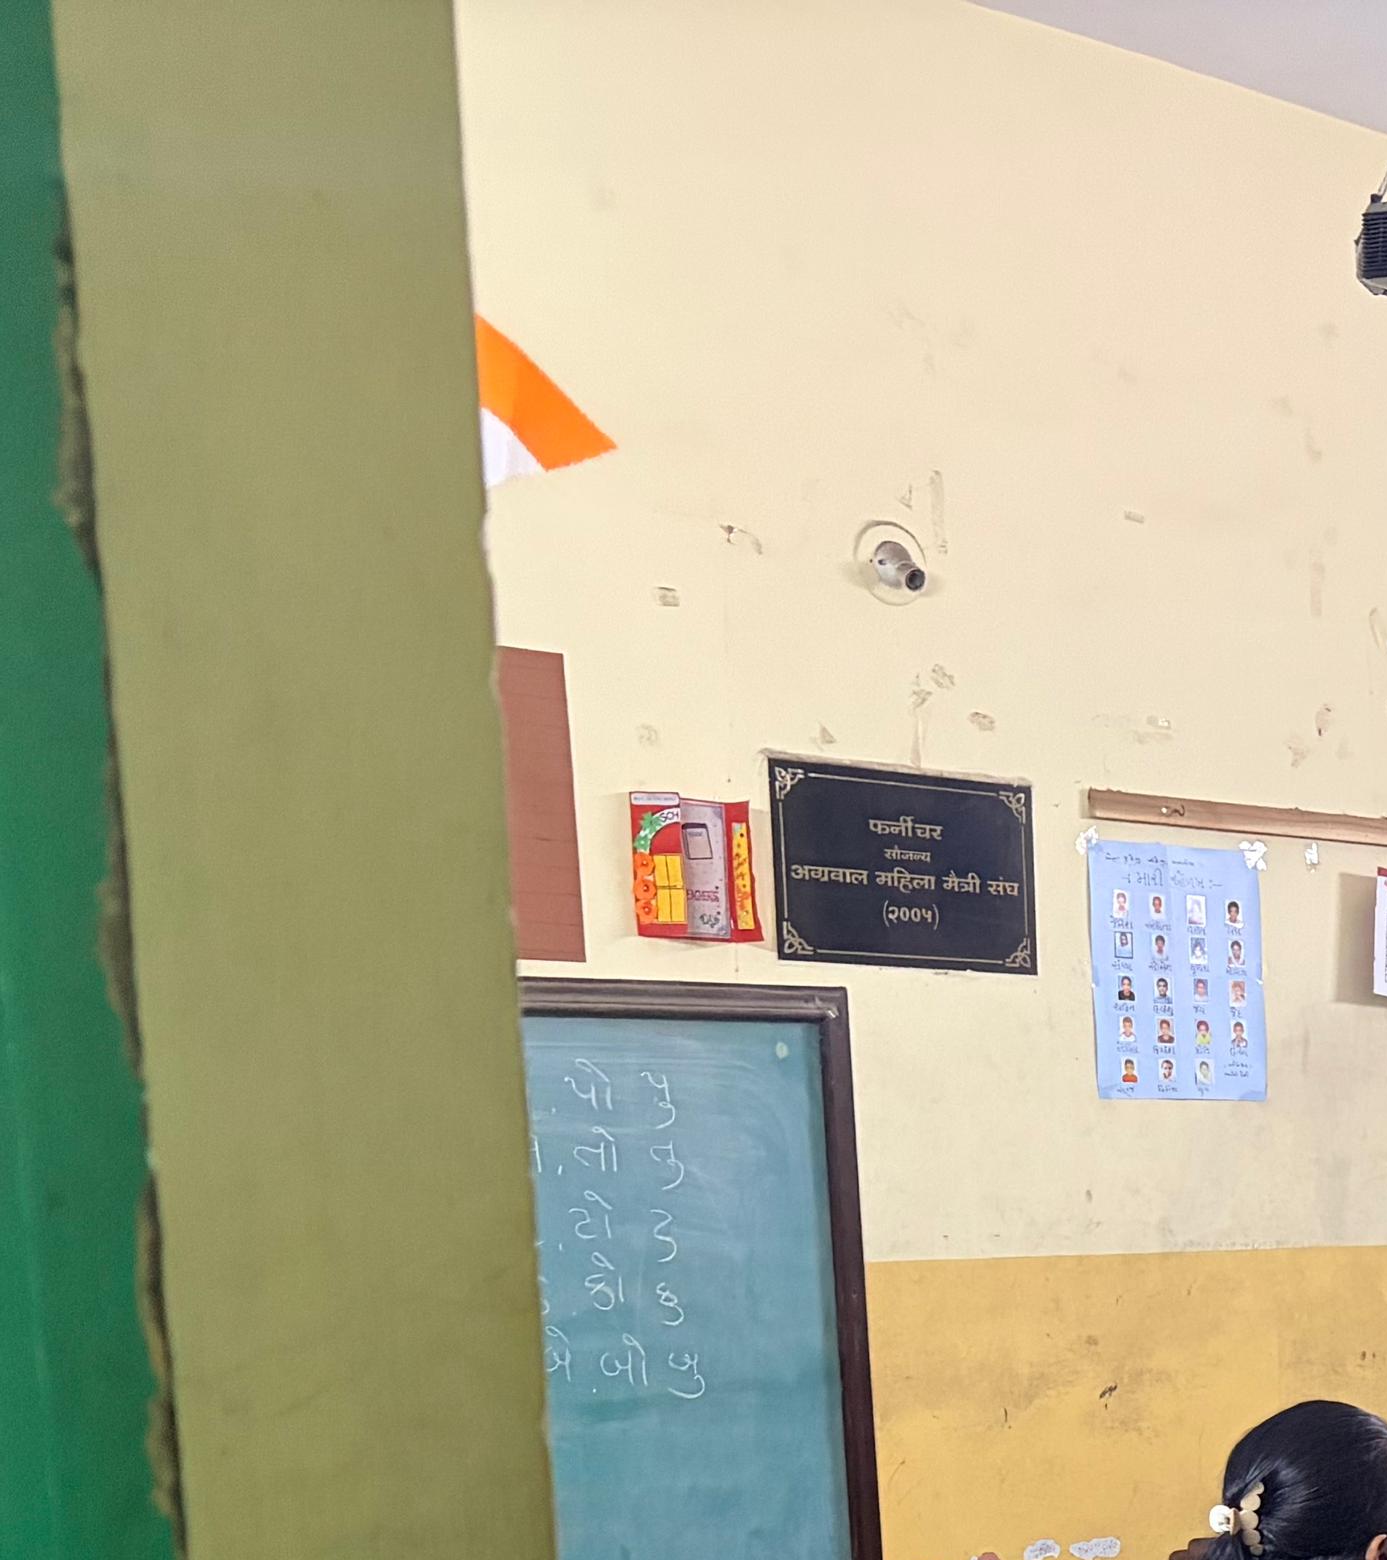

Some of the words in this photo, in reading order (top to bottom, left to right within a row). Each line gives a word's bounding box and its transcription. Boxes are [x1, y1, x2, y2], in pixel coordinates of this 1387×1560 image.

[868, 816, 944, 841] फर्नीचर
[883, 845, 931, 862] सौजन्य
[790, 864, 868, 885] अग्रवाल
[875, 868, 936, 894] महिला
[942, 870, 981, 894] मैत्री
[987, 876, 1019, 896] संघ
